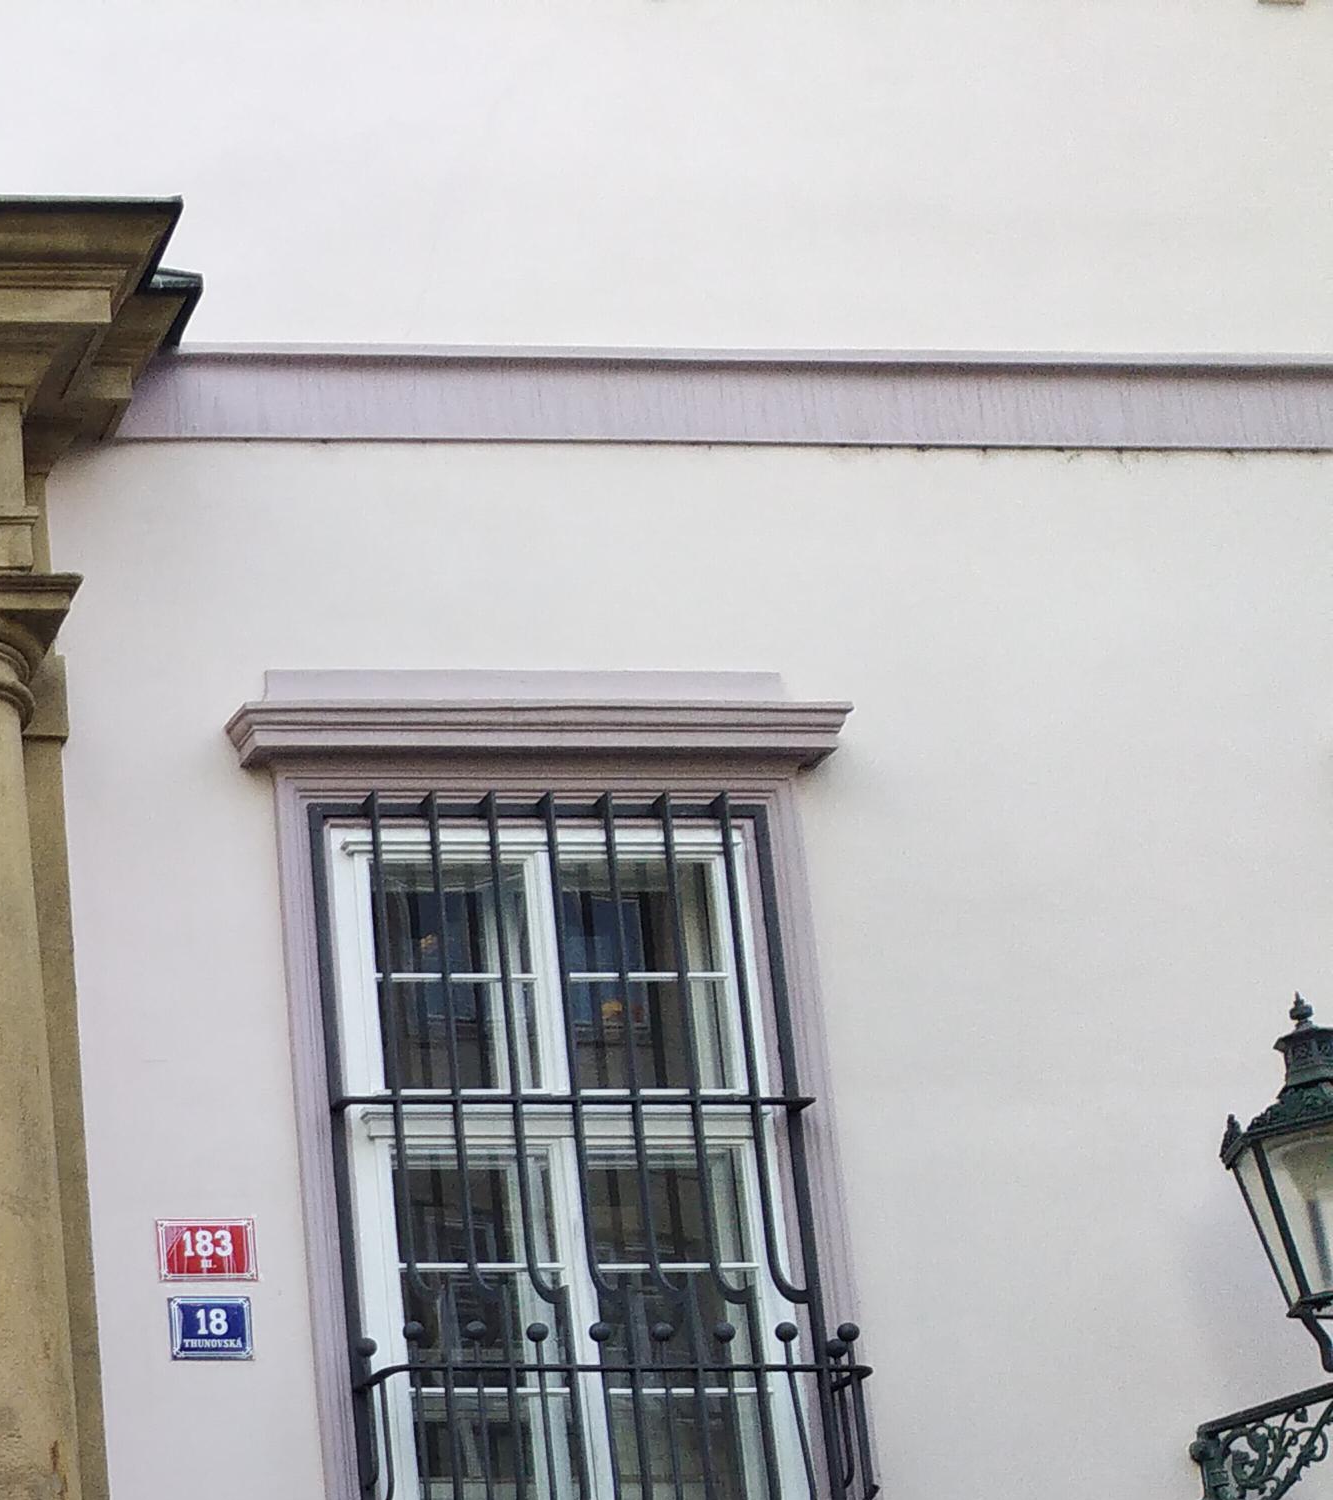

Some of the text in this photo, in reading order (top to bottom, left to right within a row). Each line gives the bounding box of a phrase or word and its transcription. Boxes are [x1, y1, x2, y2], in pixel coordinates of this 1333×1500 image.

[183, 1229, 234, 1257] 183
[196, 1308, 229, 1335] 18
[183, 1337, 243, 1348] THUNOVSKÁ
